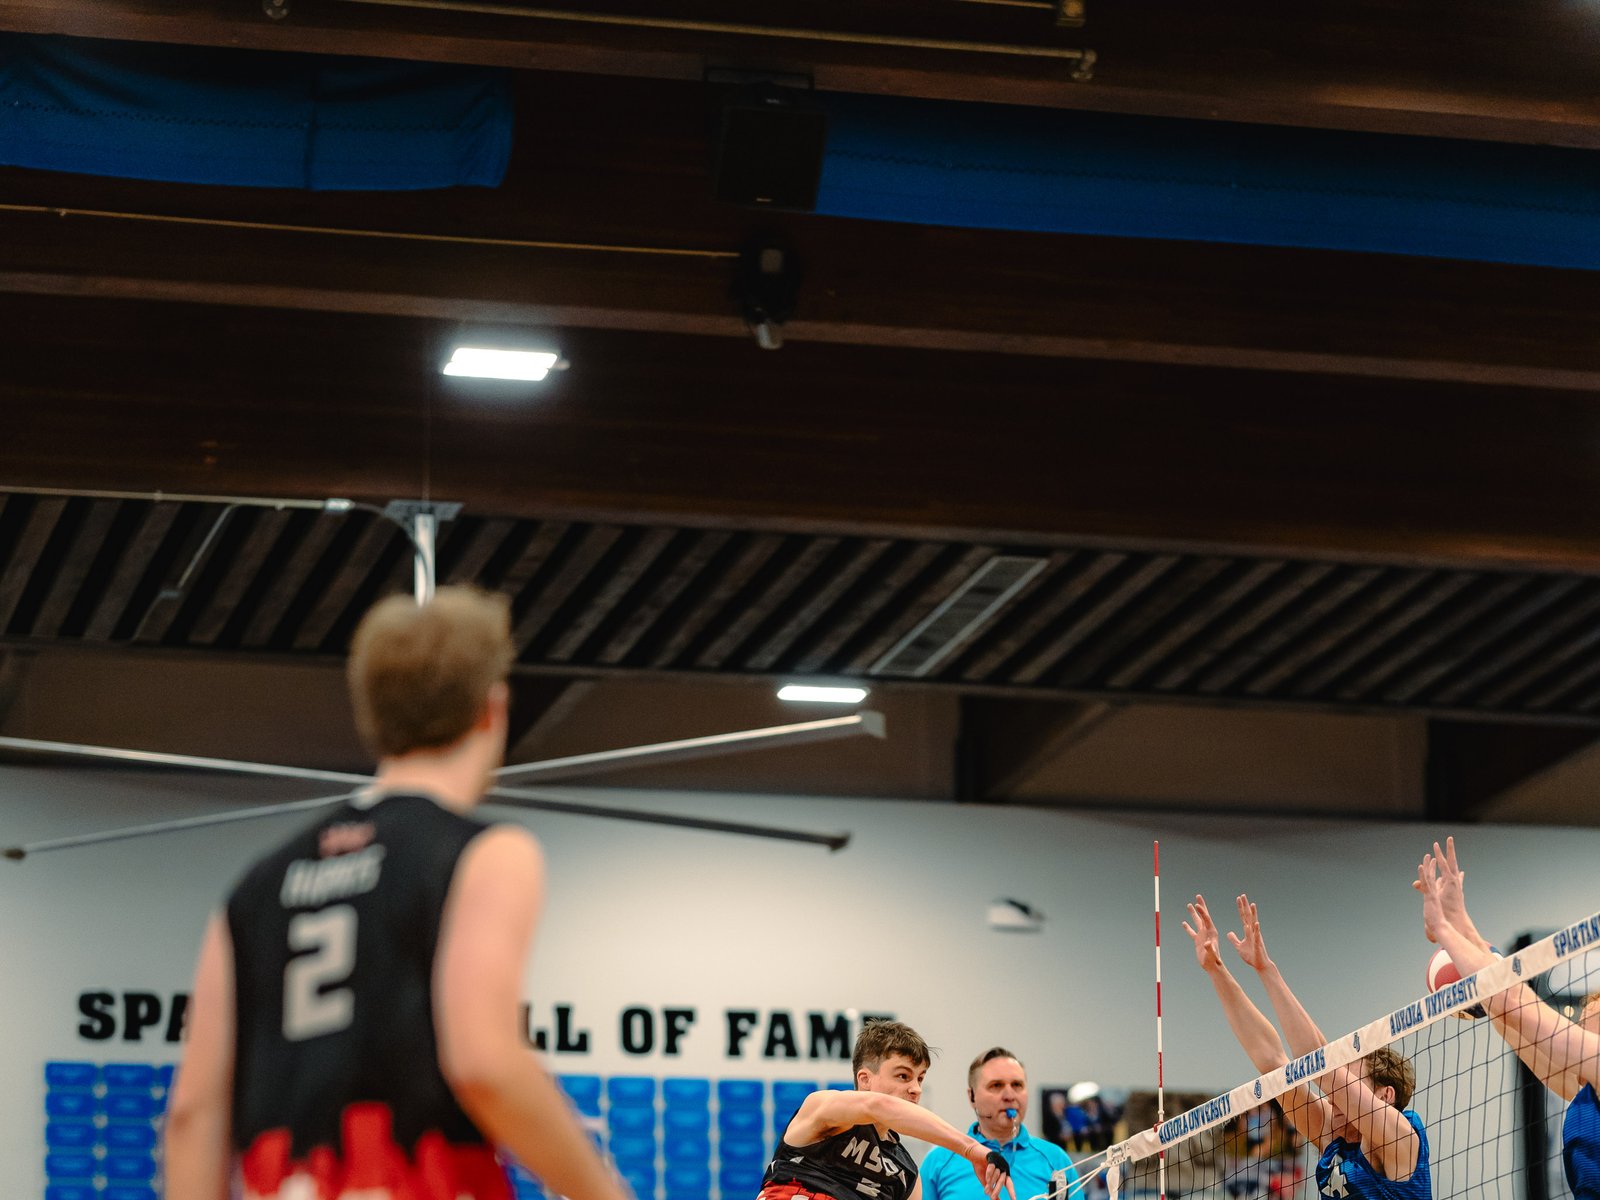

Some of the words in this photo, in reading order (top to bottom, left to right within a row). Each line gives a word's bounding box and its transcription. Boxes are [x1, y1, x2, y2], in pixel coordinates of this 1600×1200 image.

[1552, 912, 1600, 959] SPARTAN
[282, 903, 359, 1042] 2
[522, 1004, 590, 1054] LL
[620, 1007, 699, 1056] OF
[1389, 1000, 1424, 1037] AURORA
[1424, 973, 1479, 1019] UNIVERSITY
[1285, 1046, 1327, 1086] SPARTANS
